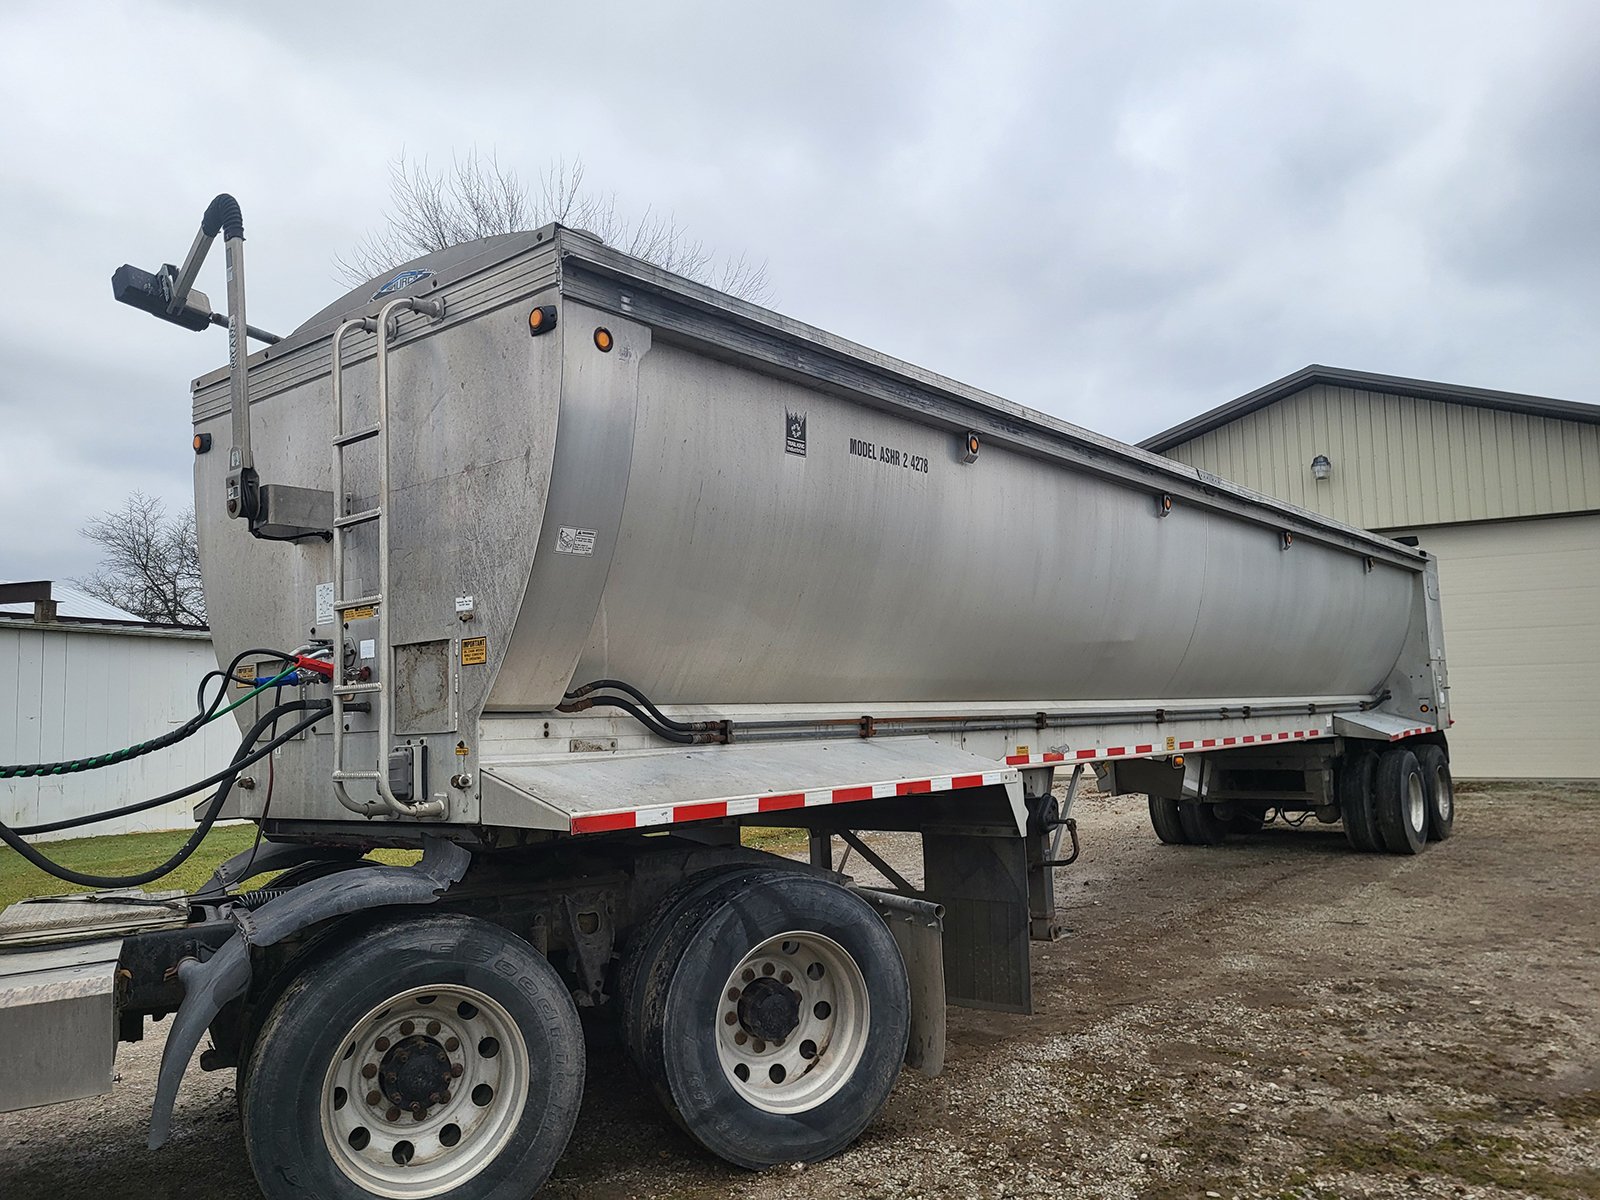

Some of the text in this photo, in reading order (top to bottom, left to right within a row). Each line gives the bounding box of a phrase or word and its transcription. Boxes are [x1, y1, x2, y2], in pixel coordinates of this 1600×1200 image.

[850, 438, 929, 474] MODEL ASHR 2 4278
